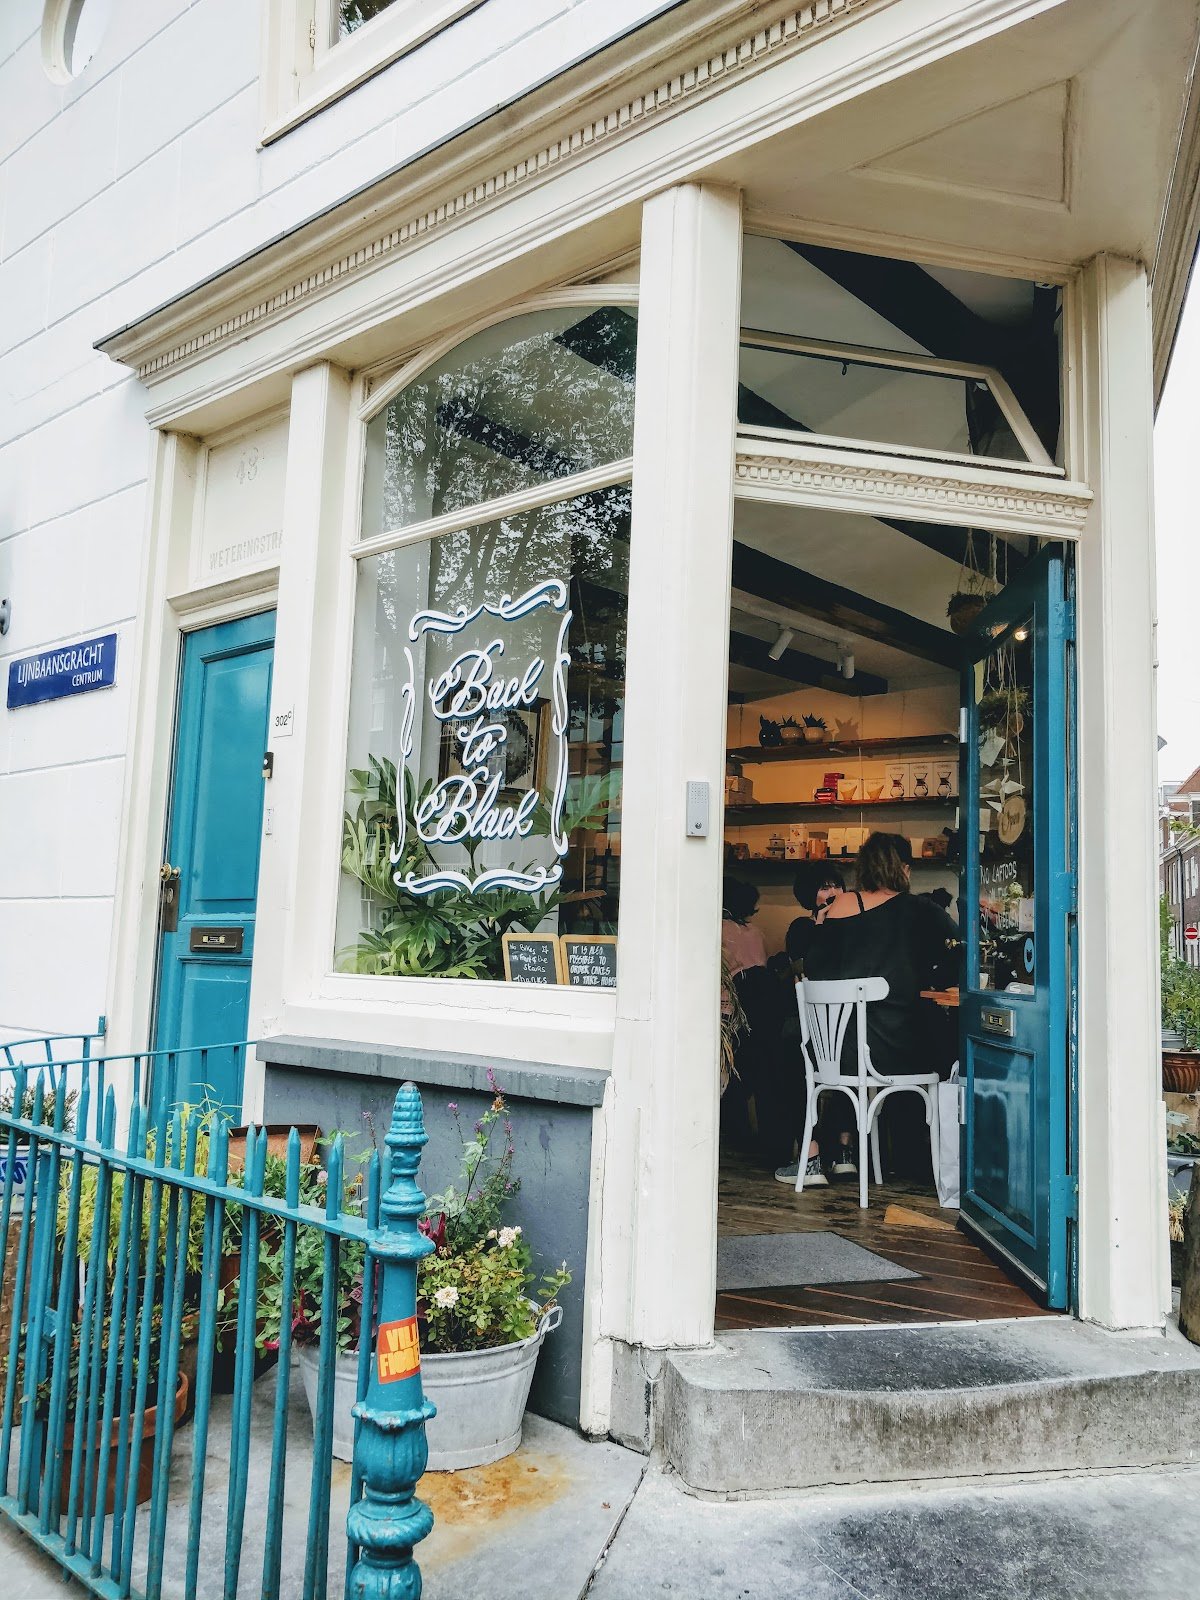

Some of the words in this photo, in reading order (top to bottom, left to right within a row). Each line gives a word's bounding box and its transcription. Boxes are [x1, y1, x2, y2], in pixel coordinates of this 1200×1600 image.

[17, 643, 104, 687] LIJNBAANSGRACHT
[72, 669, 103, 687] CENTRUM
[428, 639, 546, 720] Back
[457, 715, 508, 768] to
[414, 765, 540, 843] Black
[599, 955, 607, 965] TO
